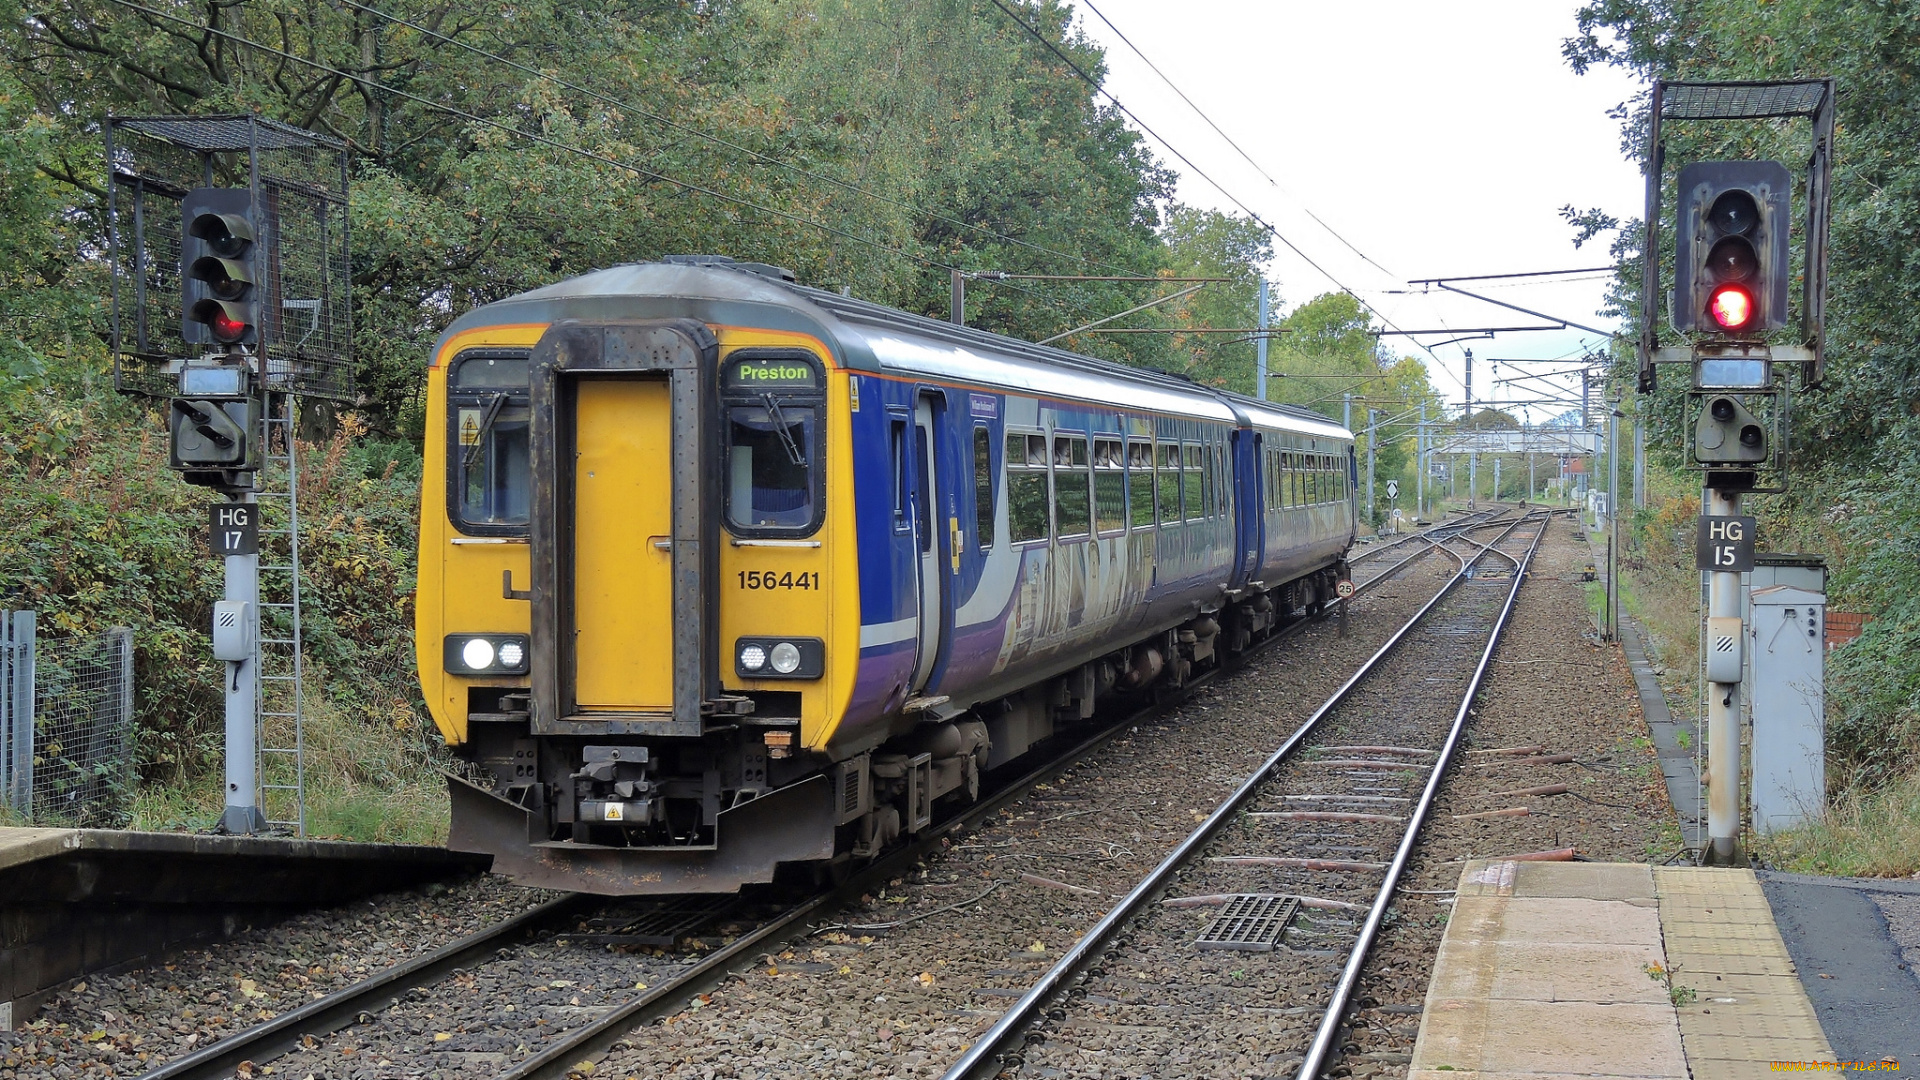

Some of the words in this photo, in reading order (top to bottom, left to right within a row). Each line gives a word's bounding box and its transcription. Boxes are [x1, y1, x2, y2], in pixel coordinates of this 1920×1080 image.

[740, 365, 808, 380] Preston
[220, 508, 248, 526] HG
[225, 531, 243, 549] 17
[1710, 521, 1743, 541] HG
[1715, 546, 1736, 566] 15
[737, 571, 819, 590] 156441
[1339, 585, 1352, 593] 25
